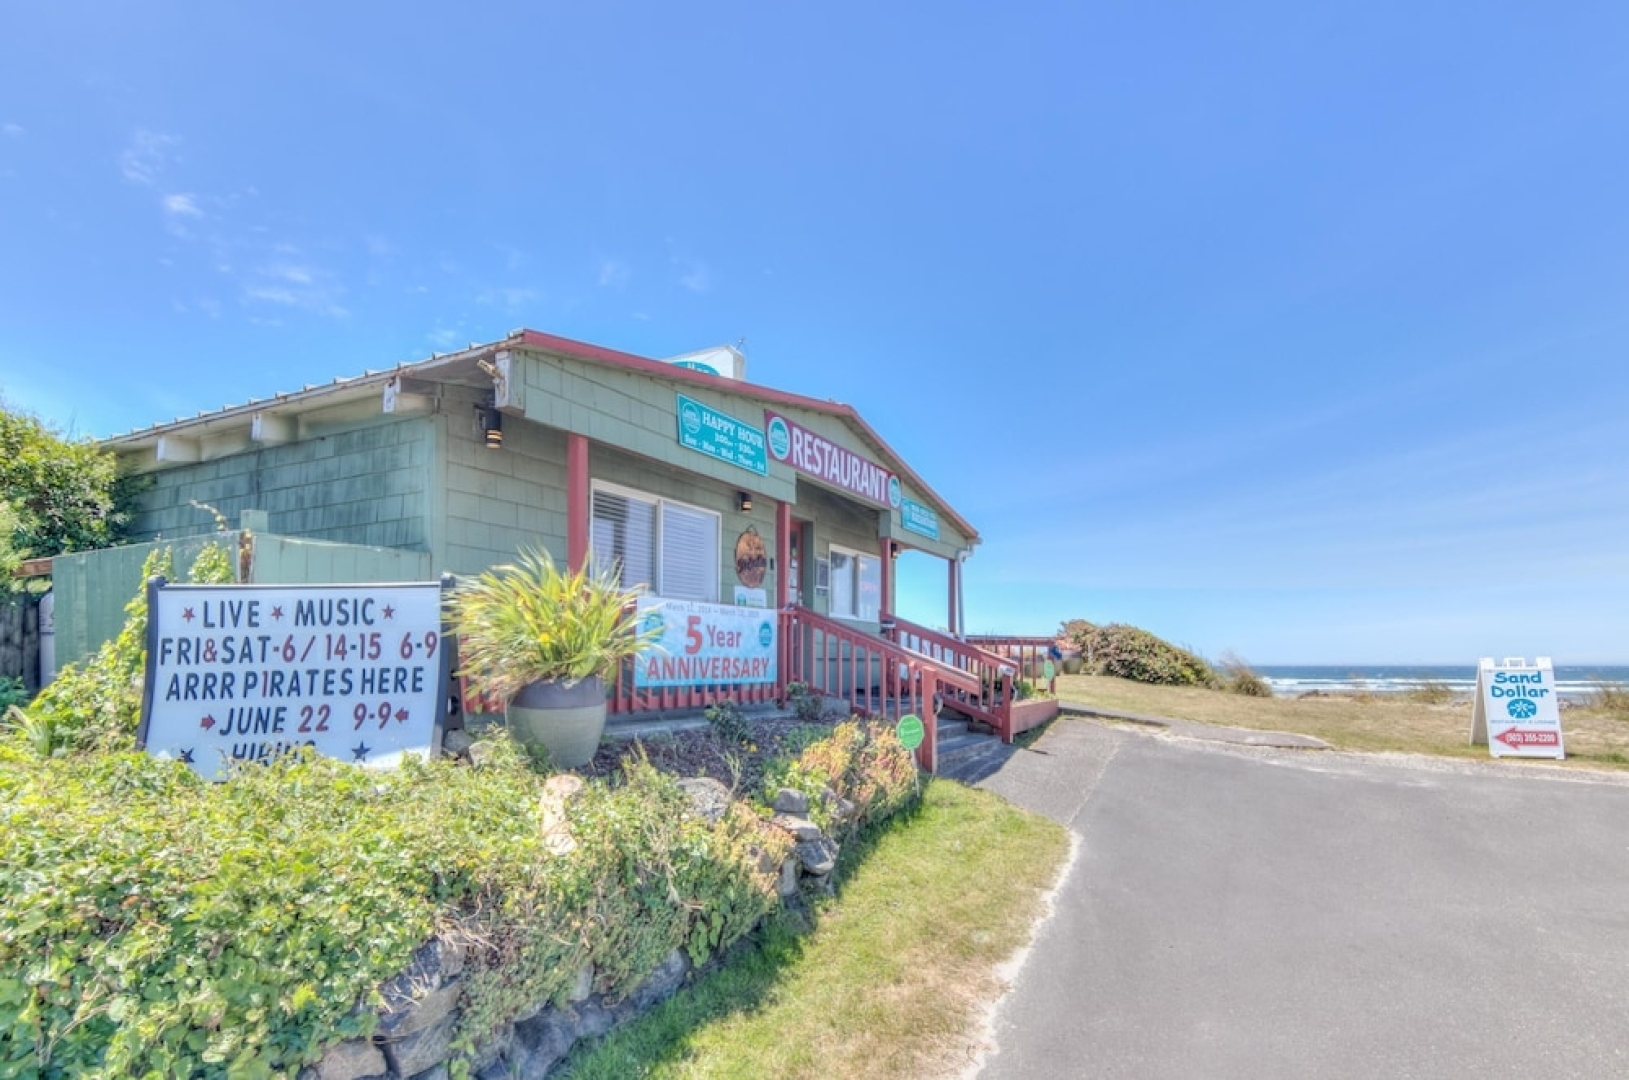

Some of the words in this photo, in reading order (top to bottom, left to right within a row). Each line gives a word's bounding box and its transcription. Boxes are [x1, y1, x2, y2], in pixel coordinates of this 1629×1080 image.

[702, 411, 736, 436] HAPPY
[738, 427, 763, 449] HOUR
[792, 426, 889, 504] RESTAURANT
[203, 600, 260, 628] LIVE
[294, 598, 375, 626] MUSIC
[400, 631, 438, 659] 6-9
[684, 616, 703, 655] 5
[706, 625, 742, 648] Year
[166, 672, 234, 701] ARRR
[360, 667, 424, 695] HERE
[646, 656, 770, 680] ANNIVERSARY
[1494, 671, 1542, 683] Sand
[1491, 686, 1549, 698] Dollar
[219, 707, 287, 736] JUNE
[298, 704, 330, 733] 22
[353, 702, 392, 730] 9-9
